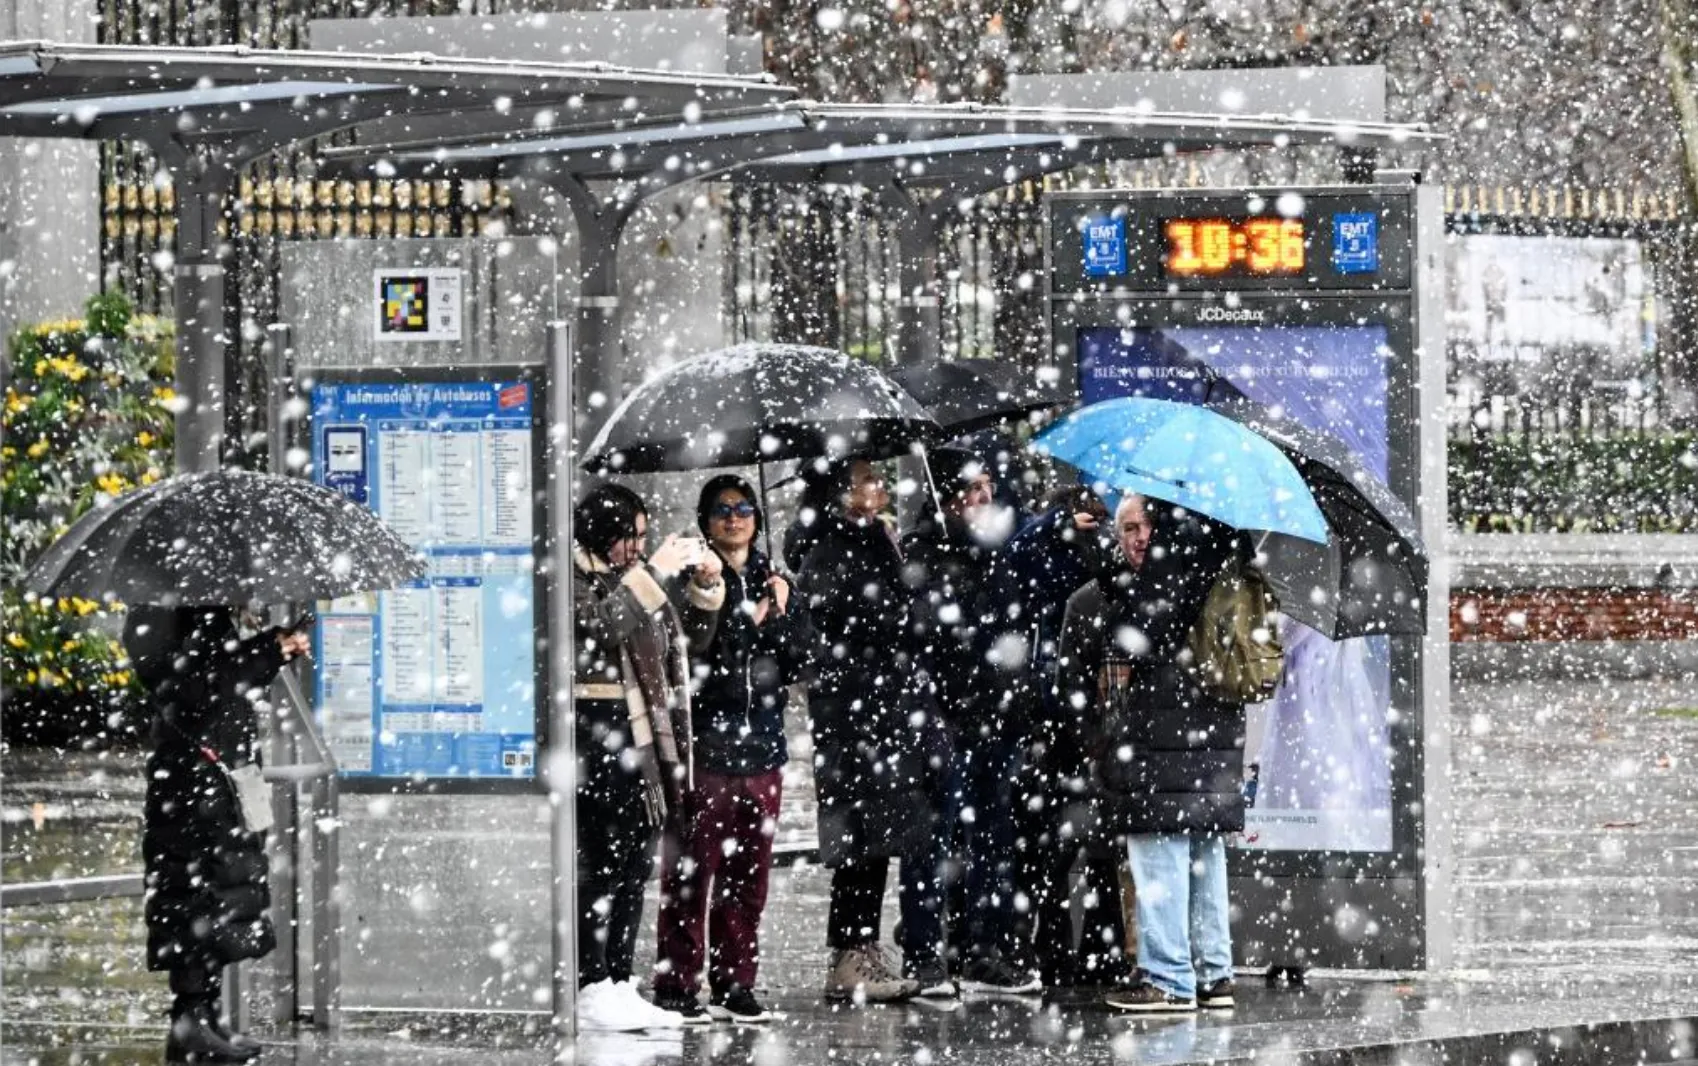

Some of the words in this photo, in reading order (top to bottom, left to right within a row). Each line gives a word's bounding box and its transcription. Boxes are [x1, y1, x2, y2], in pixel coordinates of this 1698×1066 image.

[1090, 226, 1117, 238] EMT
[1340, 222, 1369, 235] EMT
[1168, 222, 1304, 268] 10:36
[1197, 307, 1264, 321] JCDecaux
[1093, 366, 1187, 379] BIENVNIDOS
[1205, 366, 1270, 379] NUESRO
[432, 387, 492, 402] Autobuses
